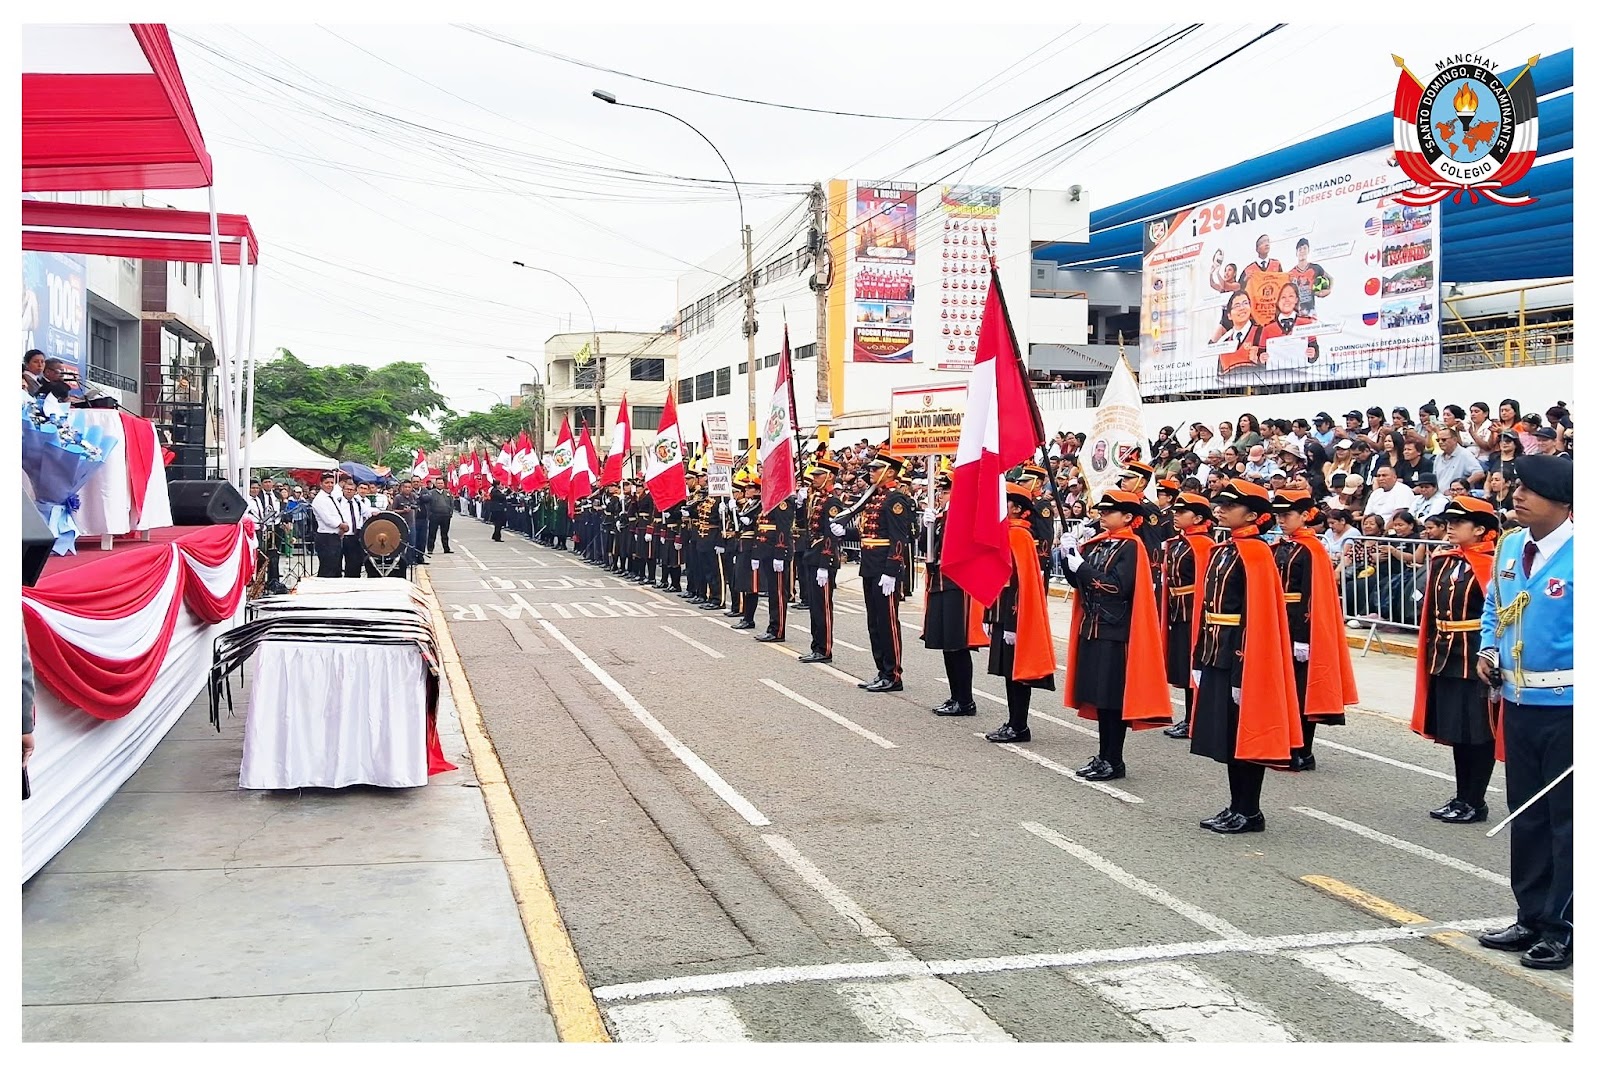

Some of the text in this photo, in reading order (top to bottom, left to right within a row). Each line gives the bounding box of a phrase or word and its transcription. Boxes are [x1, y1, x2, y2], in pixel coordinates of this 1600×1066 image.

[1297, 188, 1333, 207] LÍDERES
[1335, 174, 1387, 197] GLOBALES
[1298, 173, 1352, 196] FORMANDO
[1153, 363, 1164, 371] YES
[914, 415, 931, 428] SANTO
